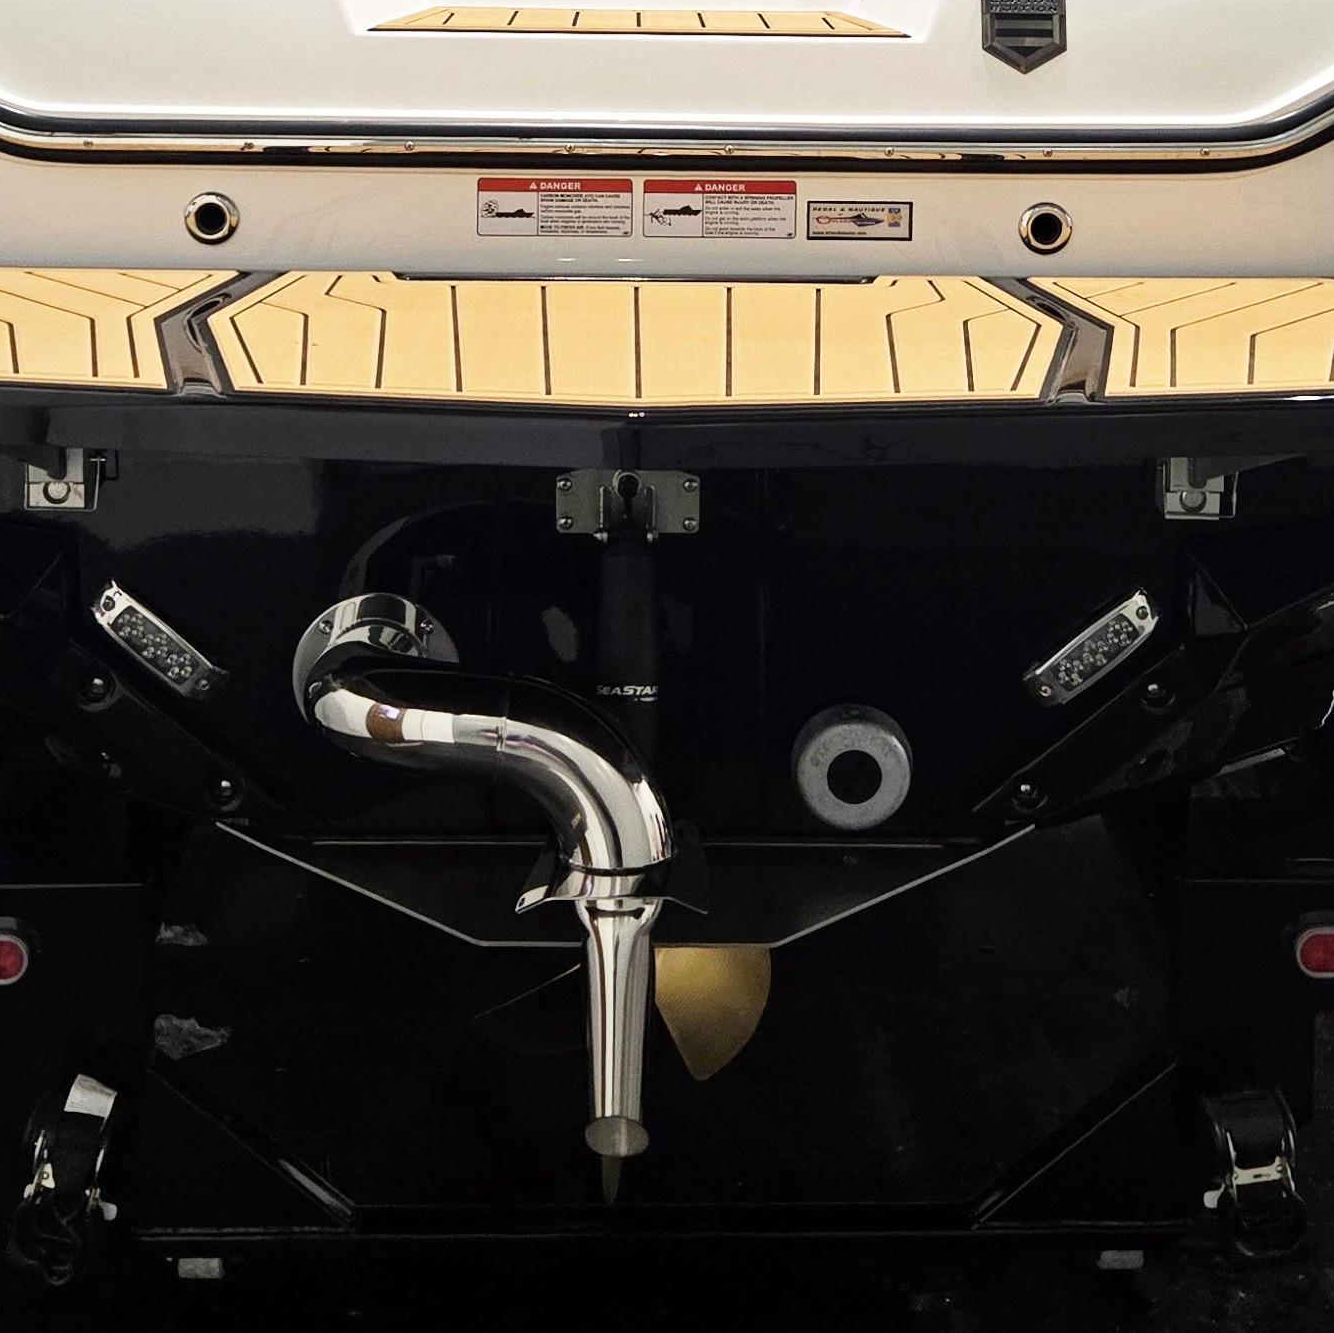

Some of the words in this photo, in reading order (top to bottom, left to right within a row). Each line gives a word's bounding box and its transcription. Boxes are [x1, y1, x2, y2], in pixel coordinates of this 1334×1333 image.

[540, 182, 581, 190] DANGER
[705, 184, 745, 192] DANGER
[596, 685, 658, 696] SEASTAR
